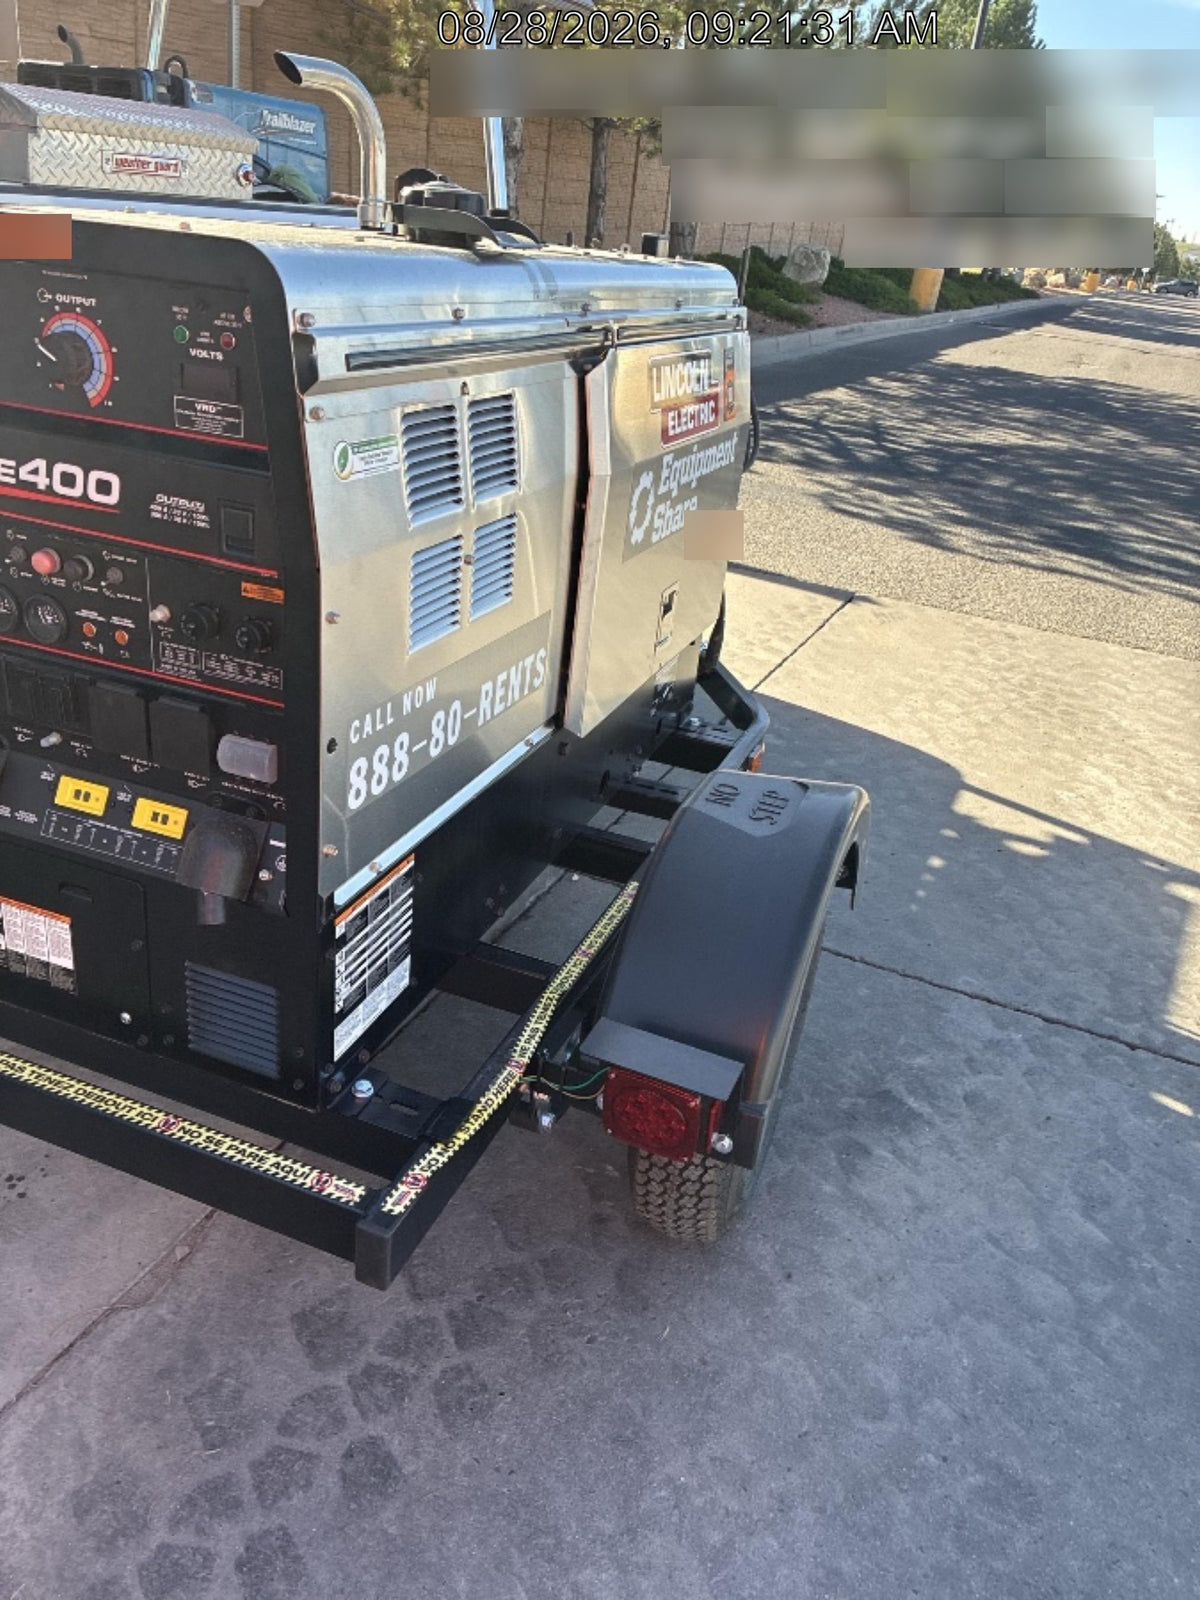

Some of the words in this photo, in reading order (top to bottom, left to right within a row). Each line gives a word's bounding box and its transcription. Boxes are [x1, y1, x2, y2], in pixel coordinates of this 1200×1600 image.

[55, 293, 96, 306] OUTPUT
[189, 348, 224, 361] VOLTS
[667, 400, 716, 436] ELECTRIC
[658, 431, 738, 498] Equipment
[347, 646, 547, 810] 888-80-RENTS
[350, 702, 394, 744] CALL
[402, 676, 438, 716] NOW
[704, 783, 740, 808] NO
[28, 1069, 75, 1092] TENEZ
[74, 1086, 135, 1114] DEBOUT
[136, 1111, 160, 1122] ICI
[492, 1069, 518, 1098] HERE
[177, 1125, 201, 1139] NO
[202, 1135, 224, 1147] SE
[226, 1144, 269, 1166] PARE
